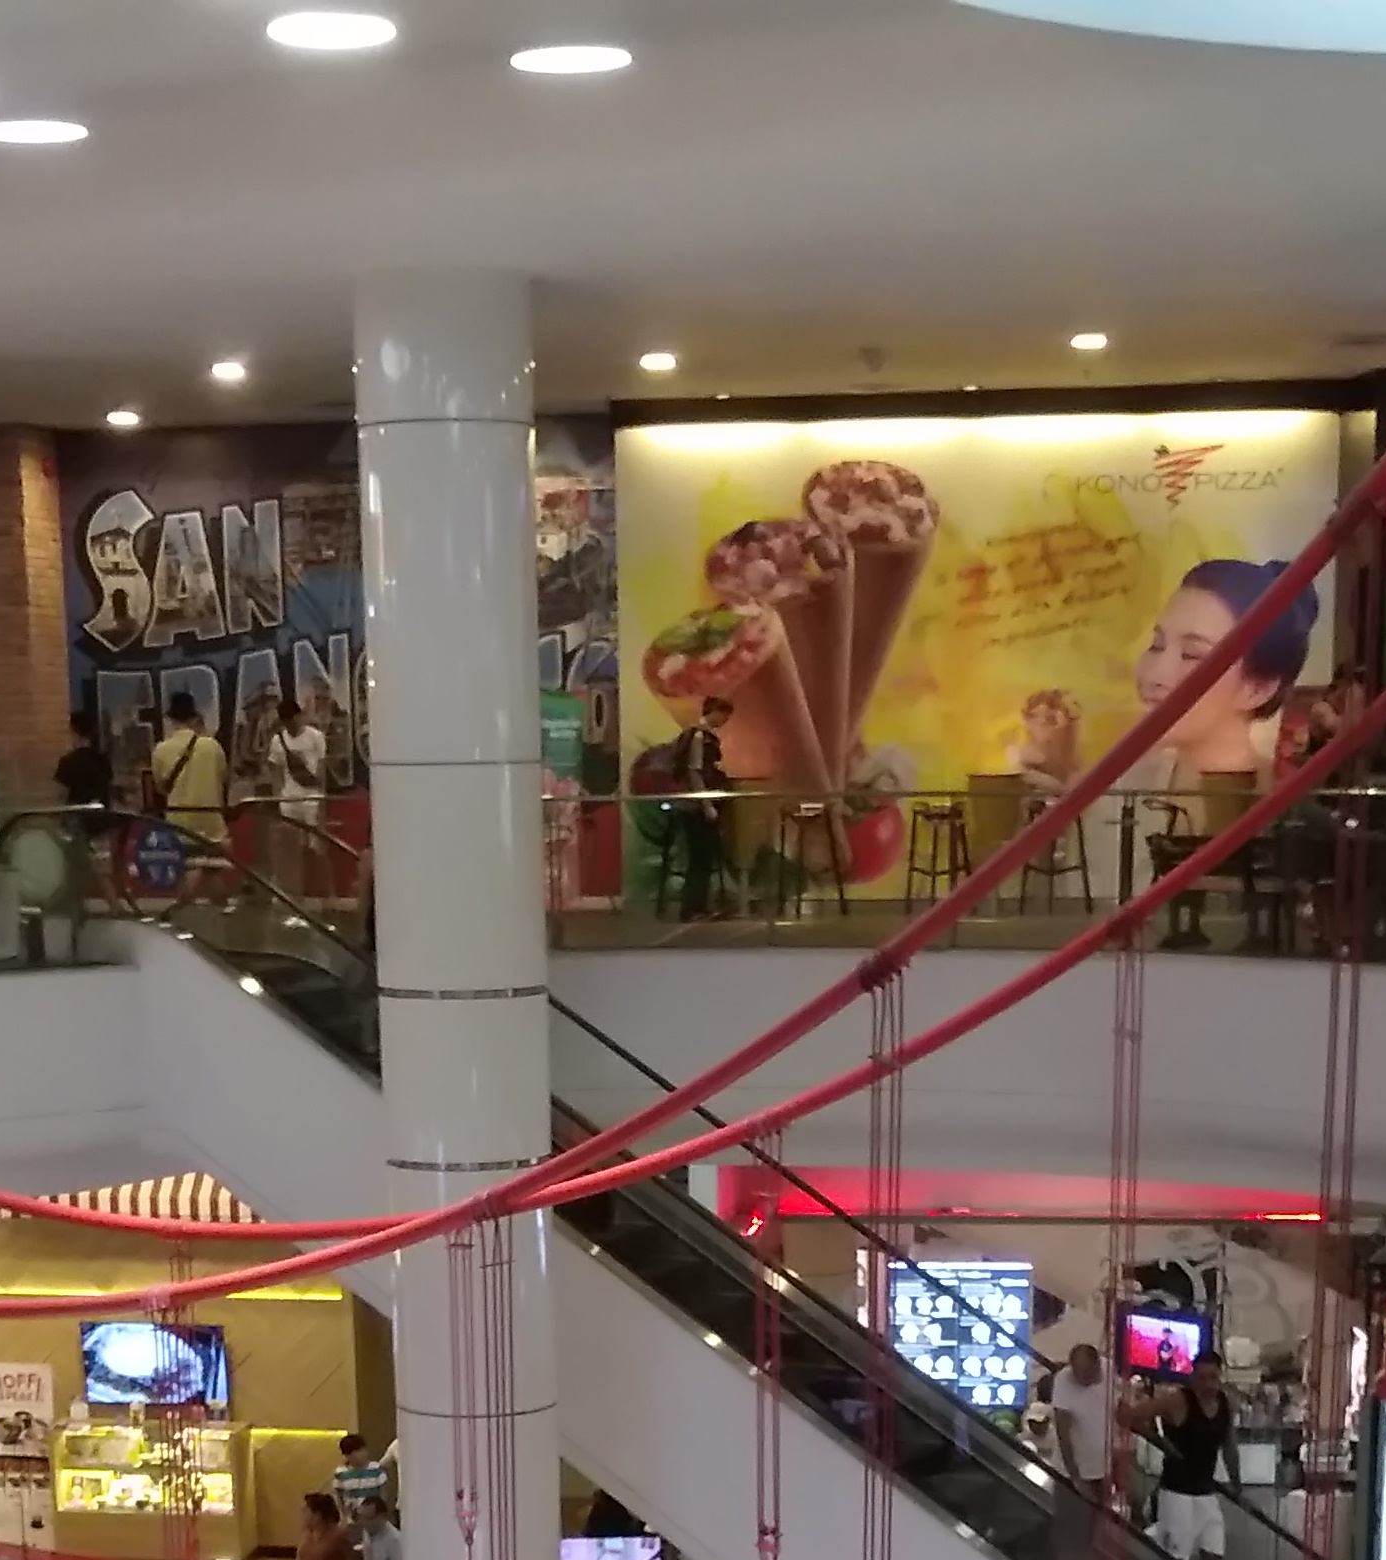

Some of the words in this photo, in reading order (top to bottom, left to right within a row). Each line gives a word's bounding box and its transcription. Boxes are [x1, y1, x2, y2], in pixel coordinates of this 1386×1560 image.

[1076, 473, 1163, 494] KONO
[1194, 470, 1279, 491] PIZZA
[83, 490, 284, 652] SAN
